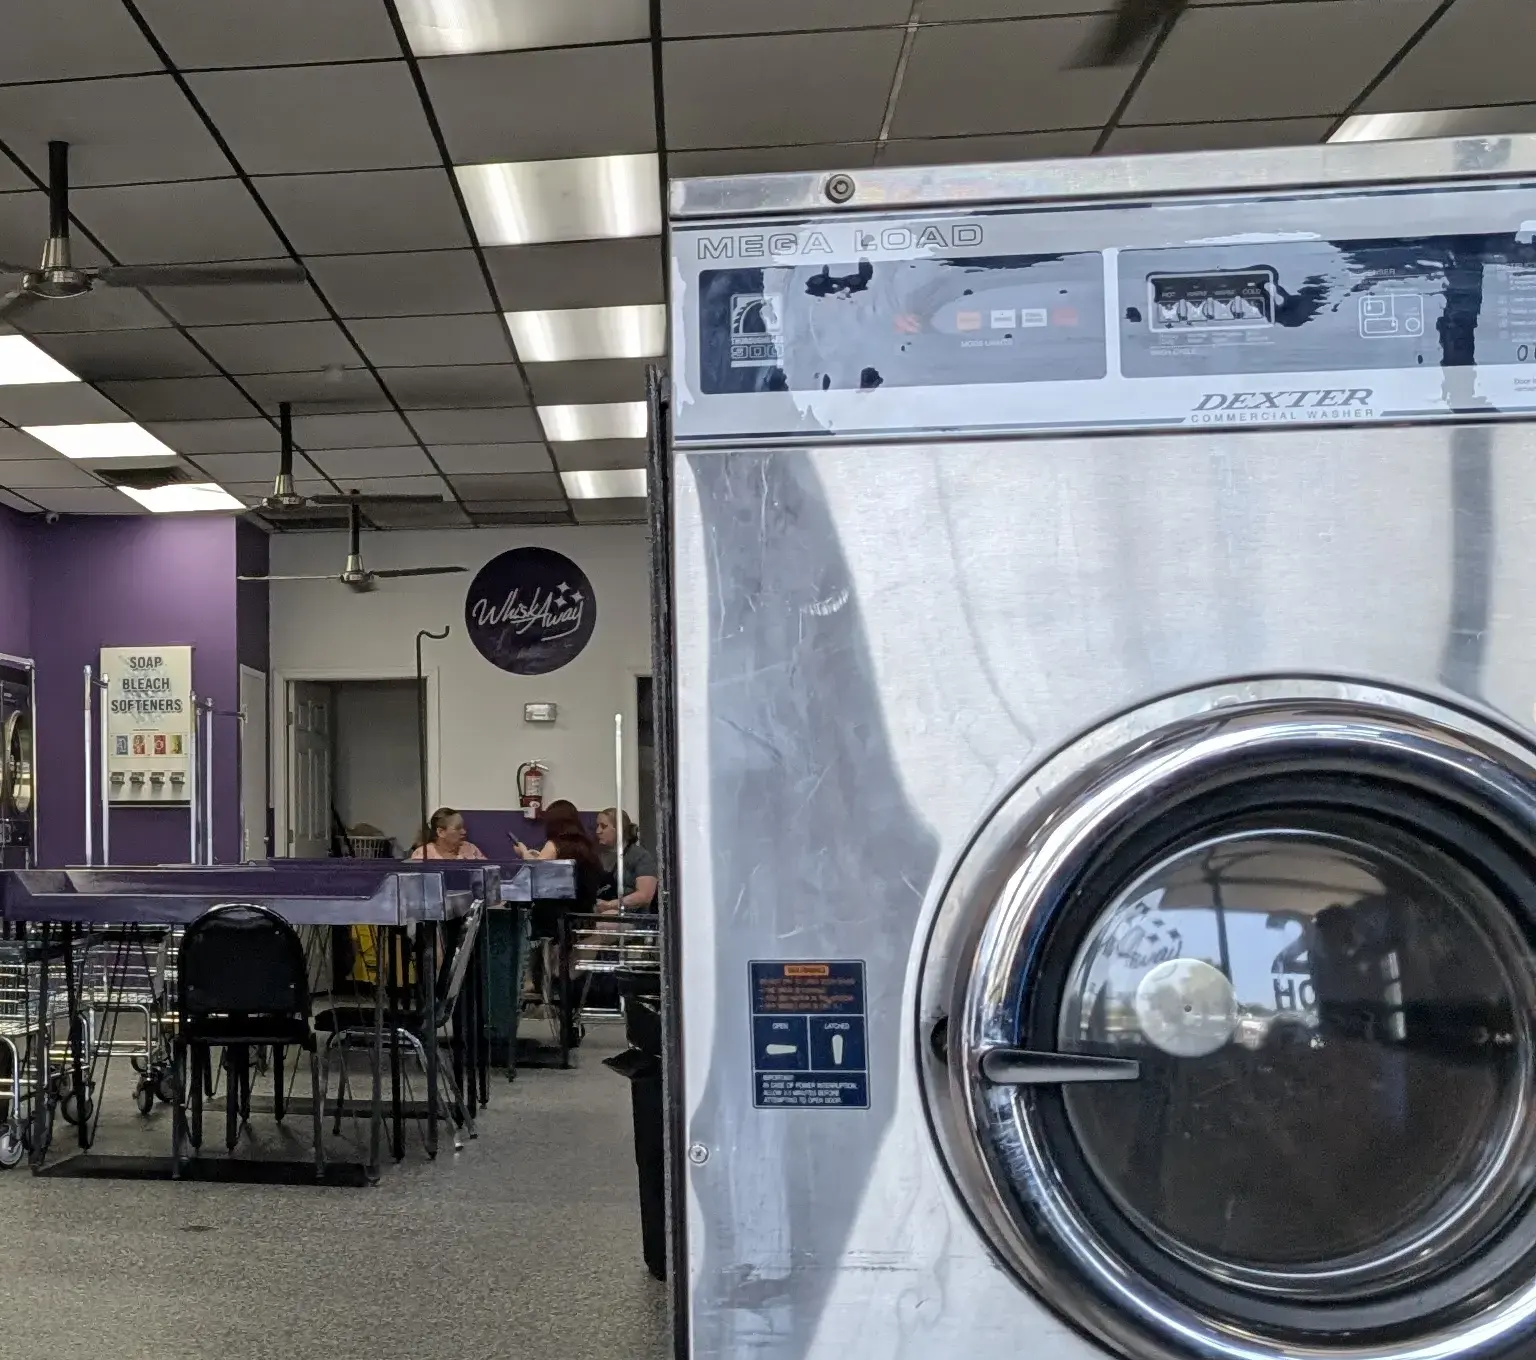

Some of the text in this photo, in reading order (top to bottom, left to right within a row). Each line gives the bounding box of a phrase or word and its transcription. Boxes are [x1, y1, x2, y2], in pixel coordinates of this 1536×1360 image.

[697, 224, 983, 260] MEGA LOAD
[1191, 388, 1374, 411] DEXTER
[1191, 408, 1374, 423] COMMERCIAL WASHER
[472, 587, 584, 641] Whisk Away
[129, 656, 163, 669] SOAP
[122, 677, 171, 690] BLEACH
[111, 699, 183, 712] SOFTENERS
